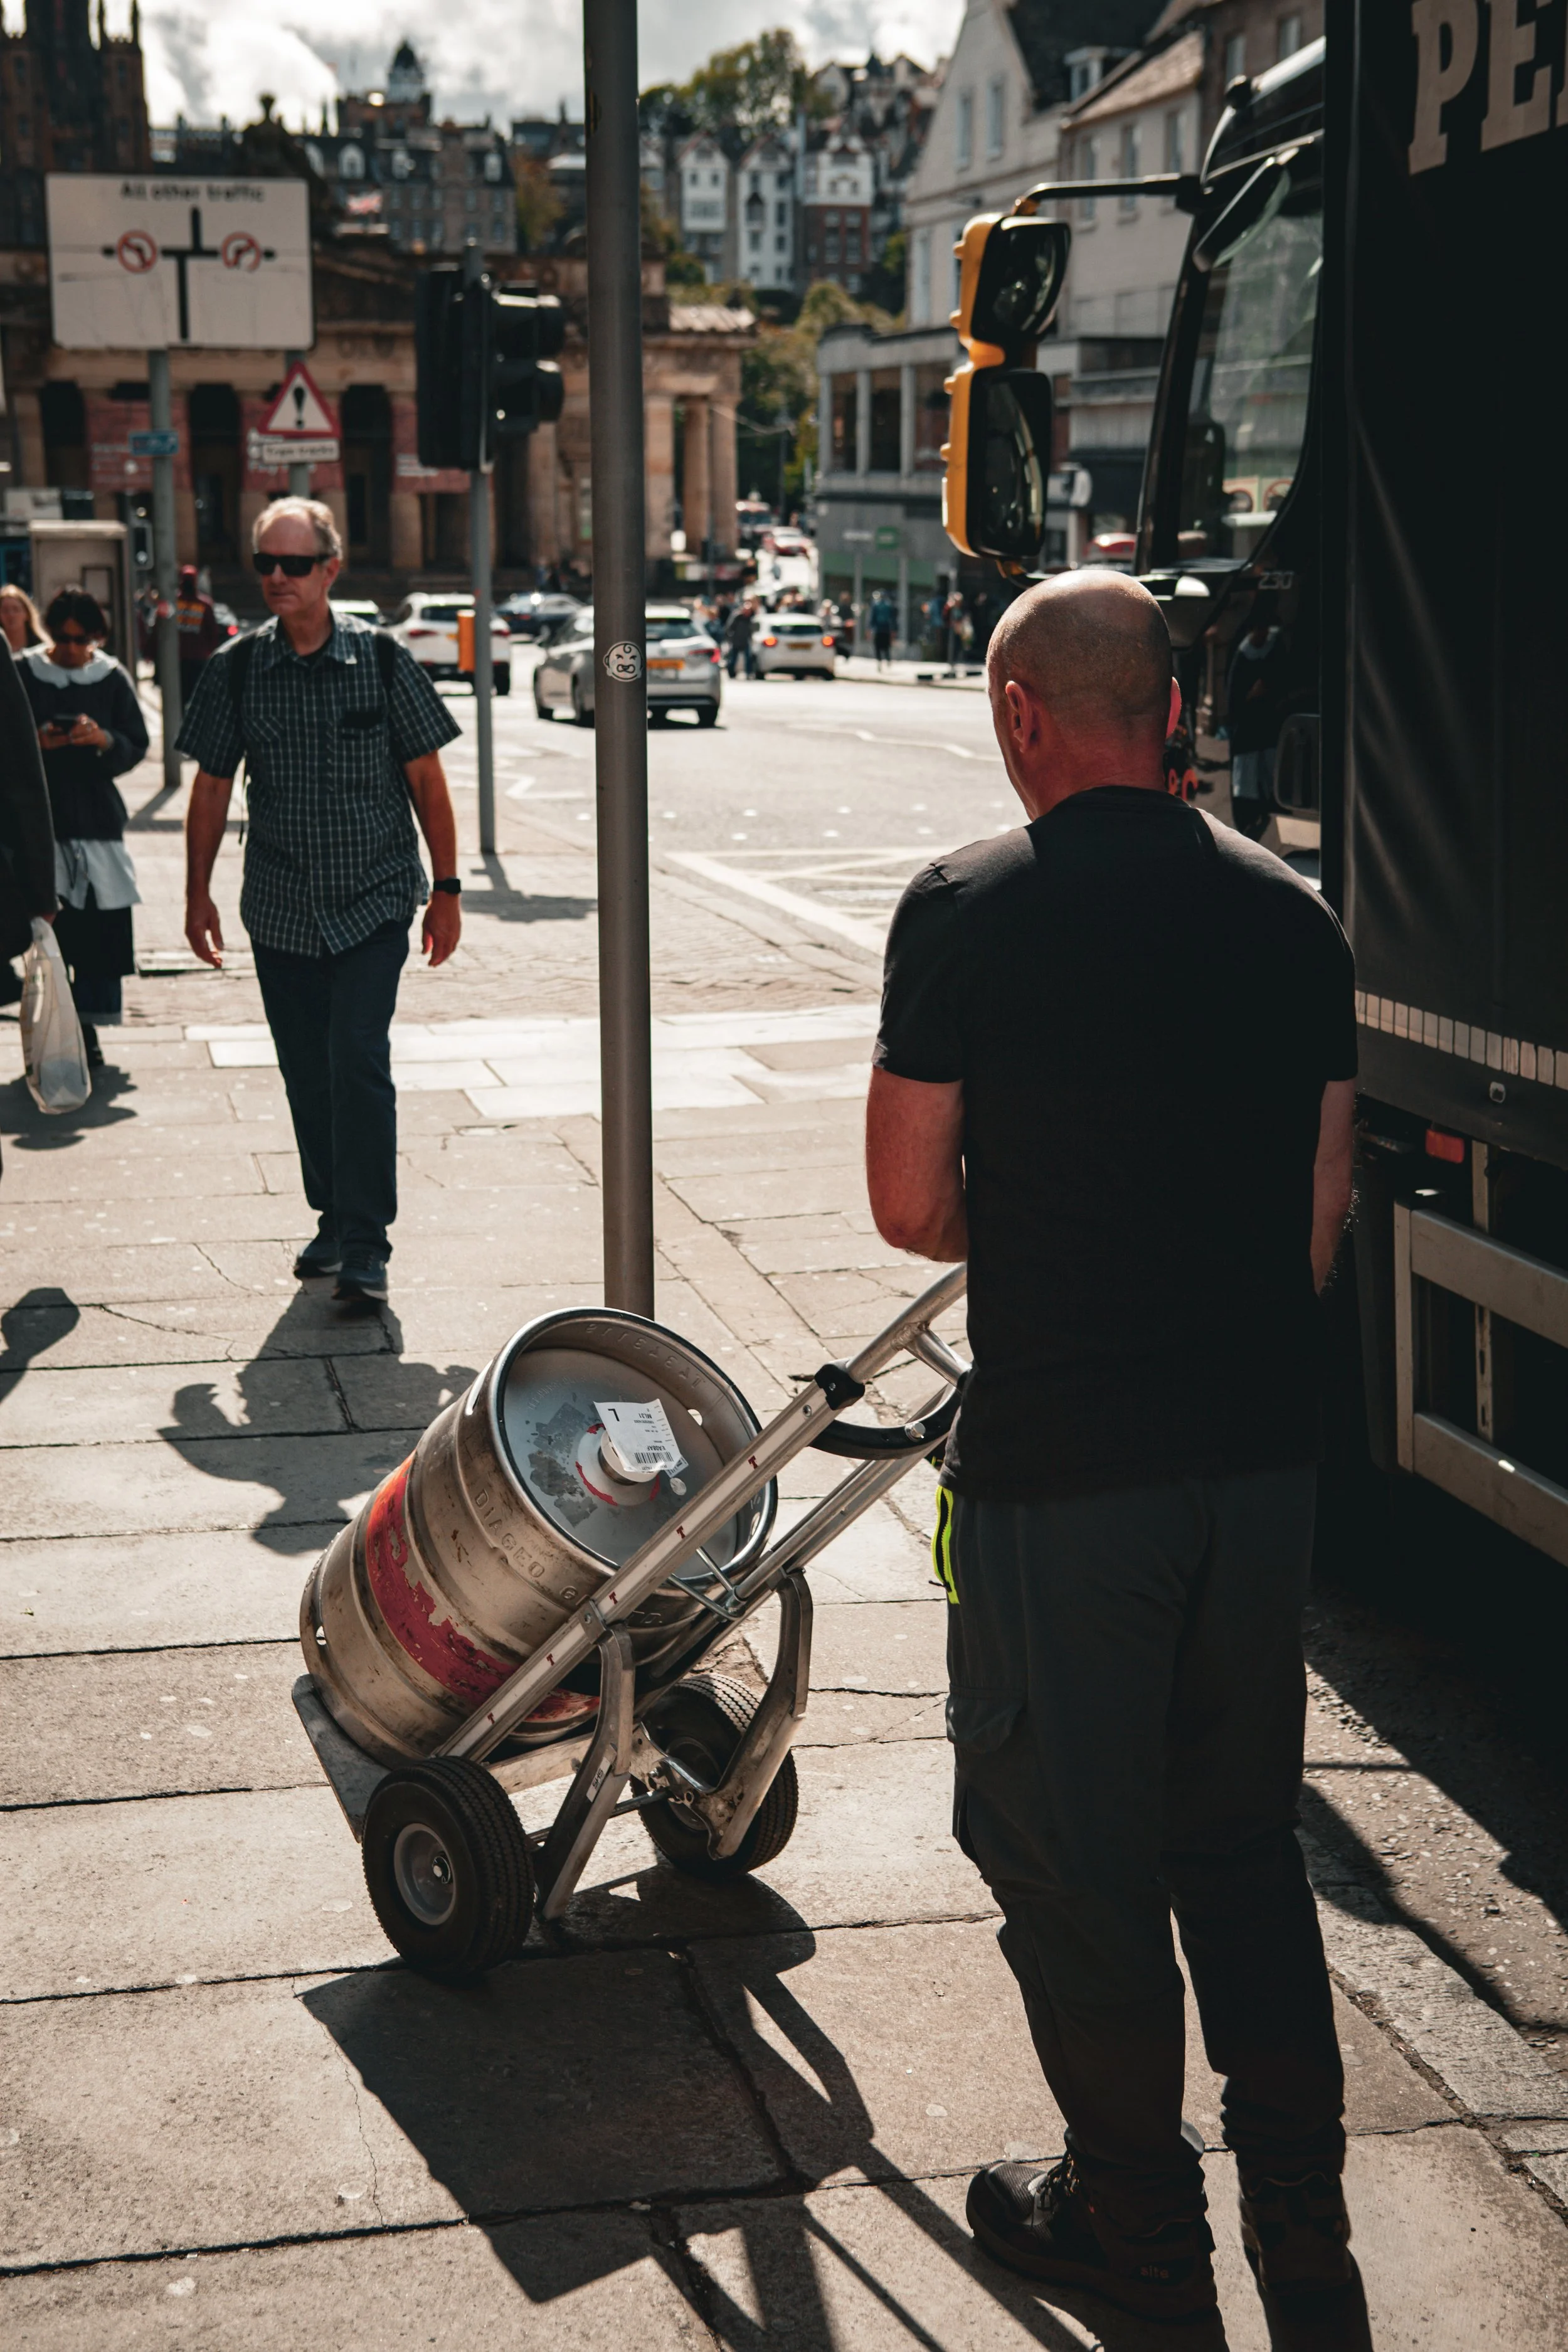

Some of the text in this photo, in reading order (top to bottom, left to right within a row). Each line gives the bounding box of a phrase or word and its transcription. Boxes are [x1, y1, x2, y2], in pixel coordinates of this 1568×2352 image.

[1408, 0, 1568, 176] PE
[121, 181, 265, 202] All other traffic
[1258, 570, 1294, 590] 230
[608, 1408, 620, 1422] L
[475, 1488, 544, 1577] DIAGEO
[1140, 2265, 1169, 2279] site
